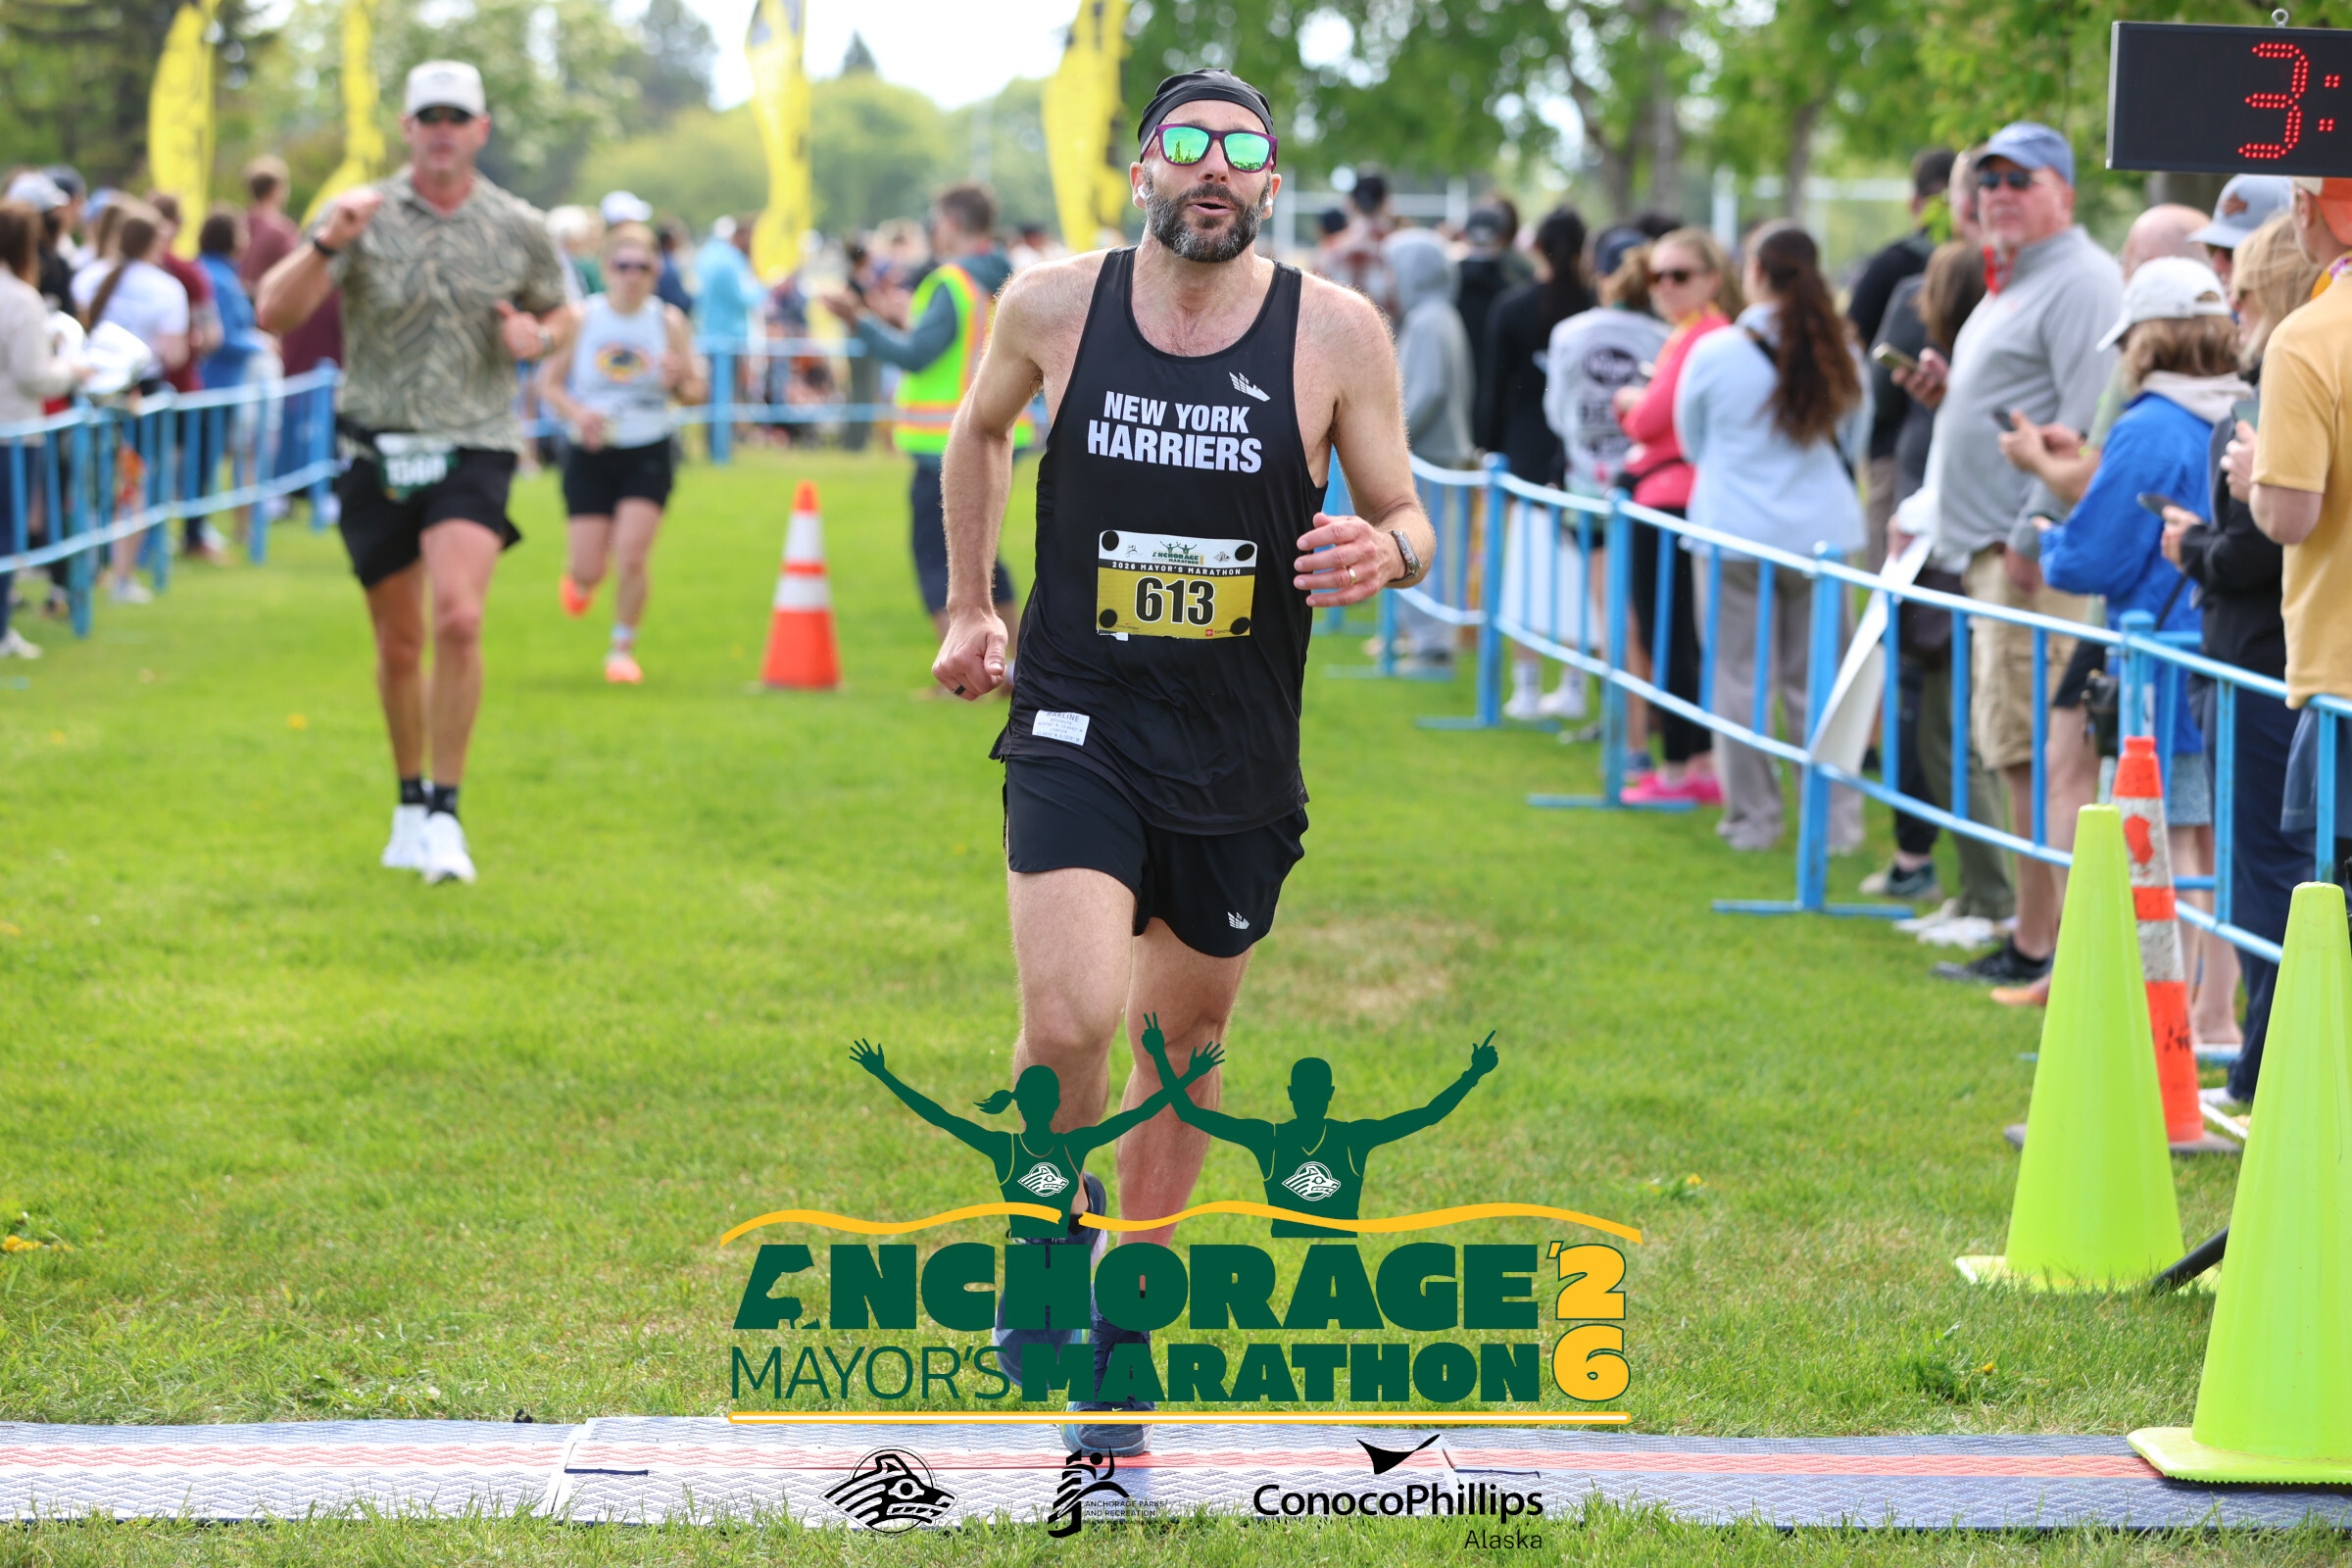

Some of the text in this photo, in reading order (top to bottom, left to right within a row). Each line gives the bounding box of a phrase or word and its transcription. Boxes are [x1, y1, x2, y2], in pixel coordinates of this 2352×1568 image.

[1103, 390, 1250, 434] NEW YORK
[1087, 418, 1262, 474] HARRIERS
[1111, 561, 1242, 576] 2026 MAYOR'S MARATHON
[1152, 551, 1200, 562] ANCHORAGE
[1134, 575, 1216, 627] 613
